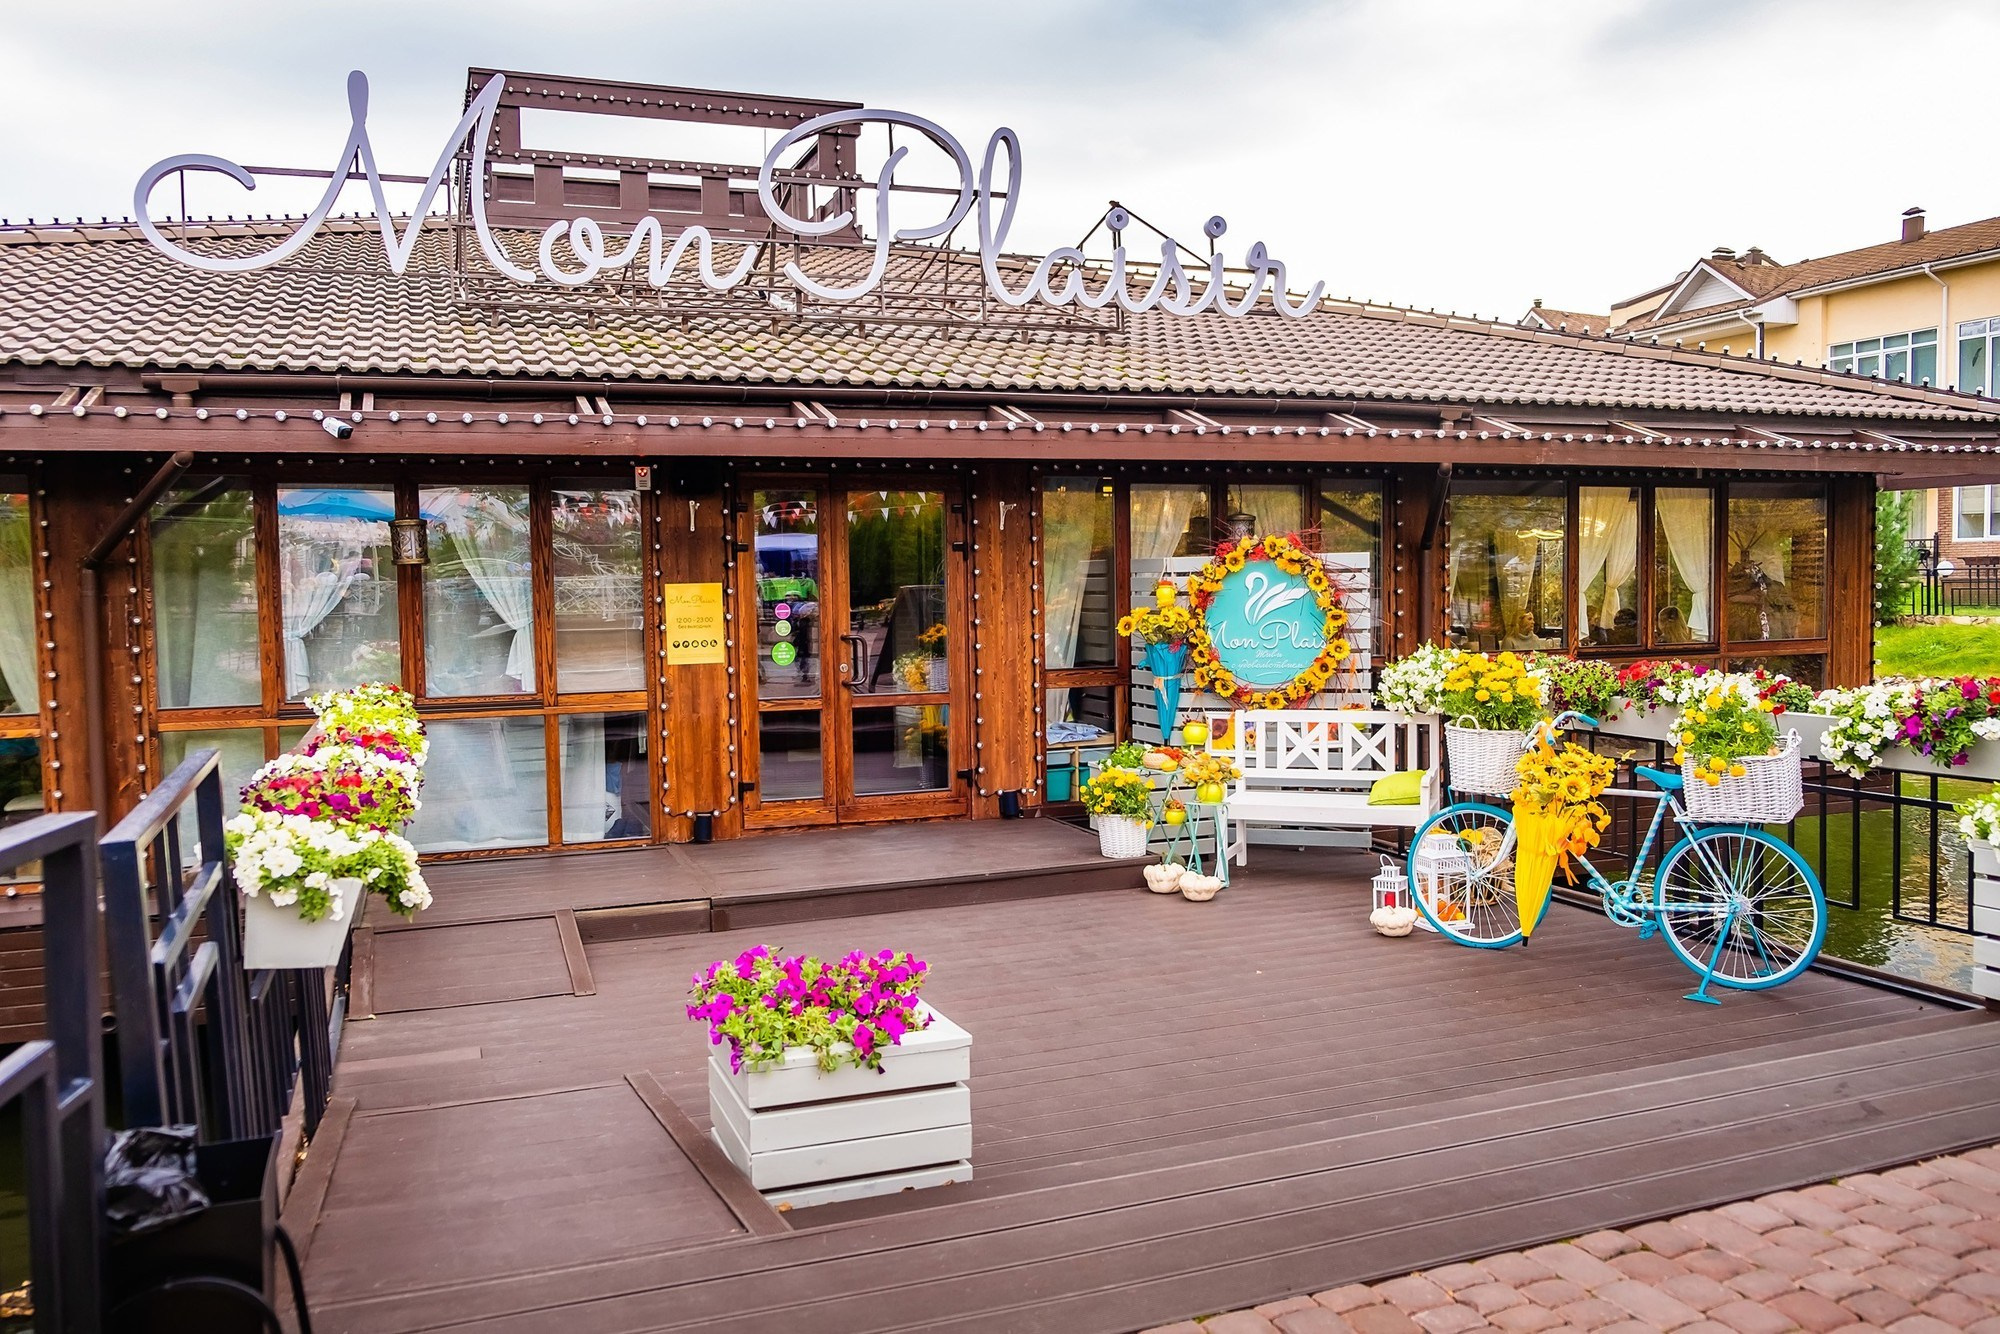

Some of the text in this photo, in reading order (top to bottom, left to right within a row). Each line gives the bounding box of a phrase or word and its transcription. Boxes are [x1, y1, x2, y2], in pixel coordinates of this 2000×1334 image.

[134, 69, 1325, 319] Mon Plaisir
[1259, 619, 1327, 650] Plais
